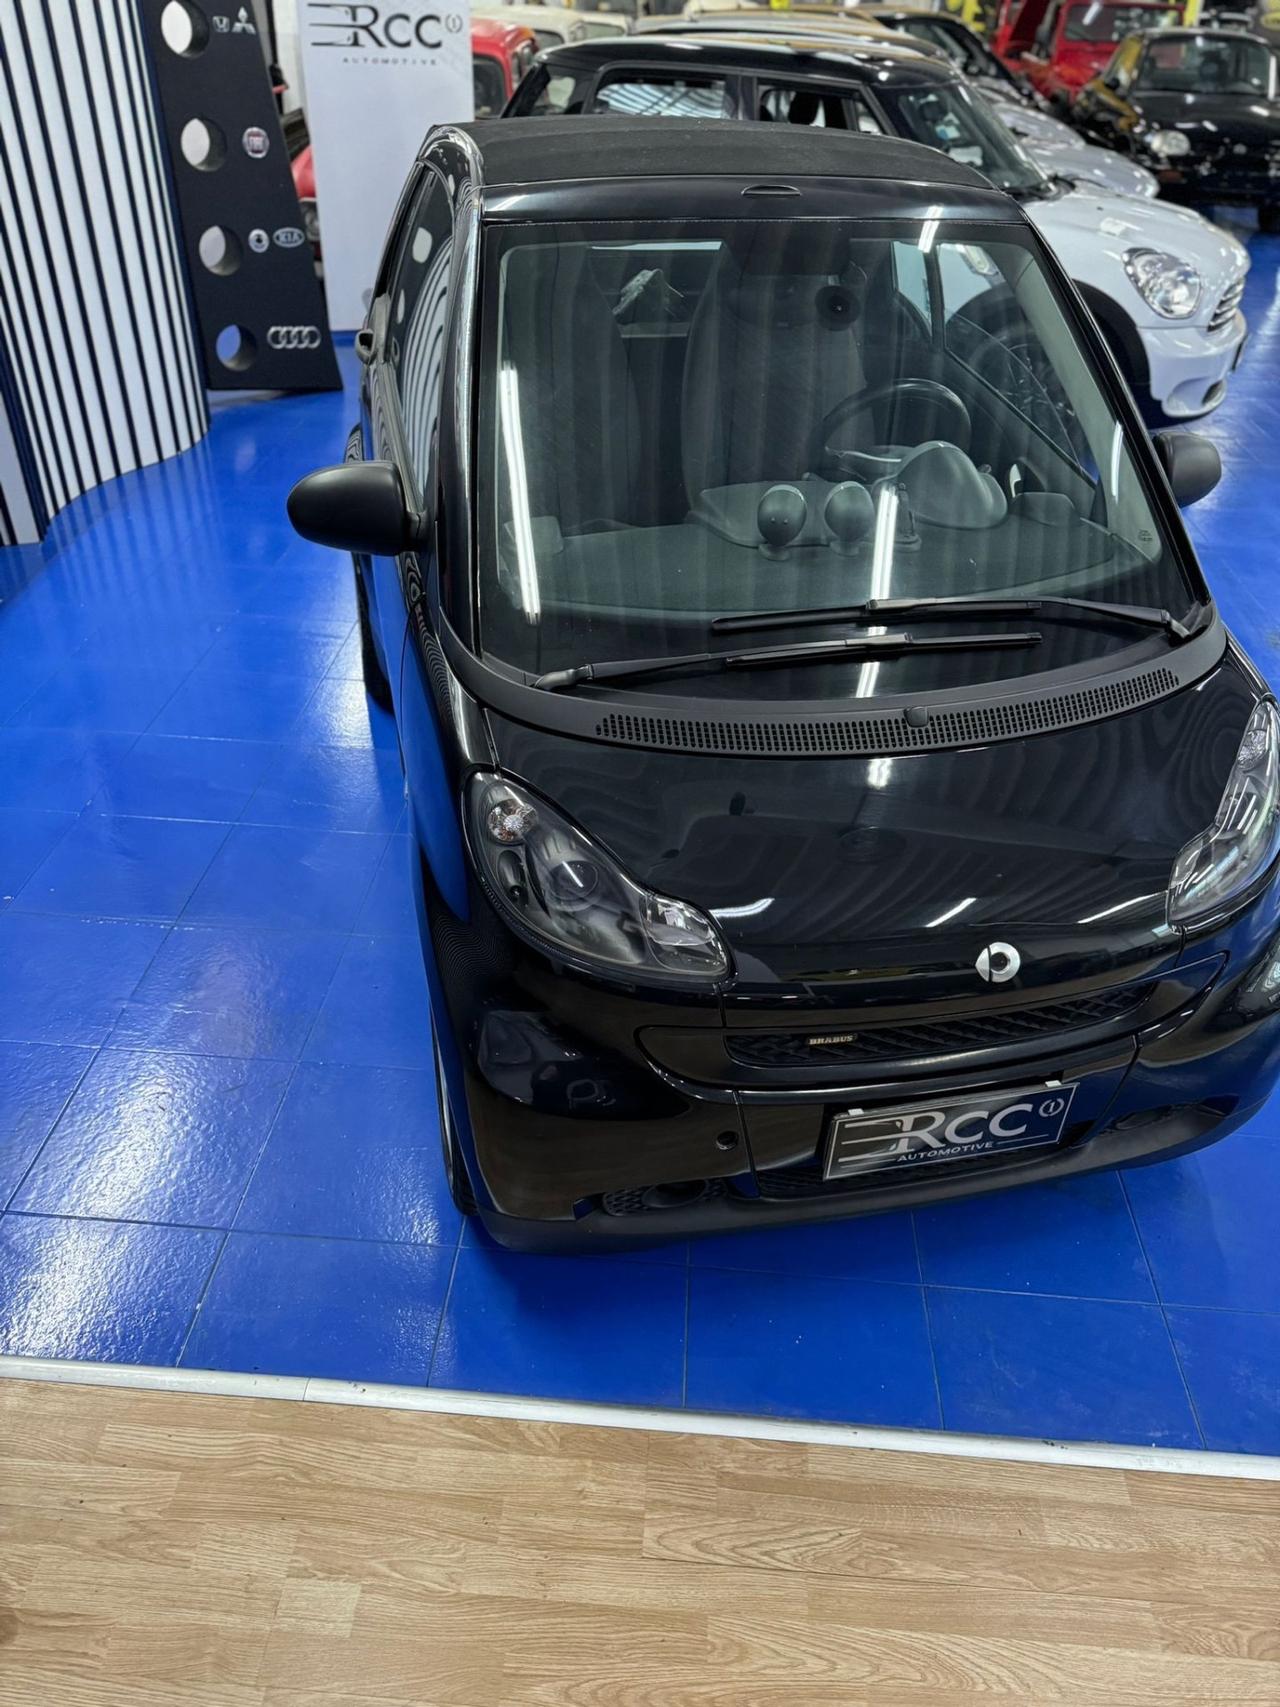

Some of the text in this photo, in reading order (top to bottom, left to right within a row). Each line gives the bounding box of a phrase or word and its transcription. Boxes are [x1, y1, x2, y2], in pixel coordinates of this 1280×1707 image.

[342, 57, 437, 66] AUTOMOTIVE
[808, 1035, 854, 1046] BRABUS
[896, 1140, 993, 1163] AUTOMOTIVE
